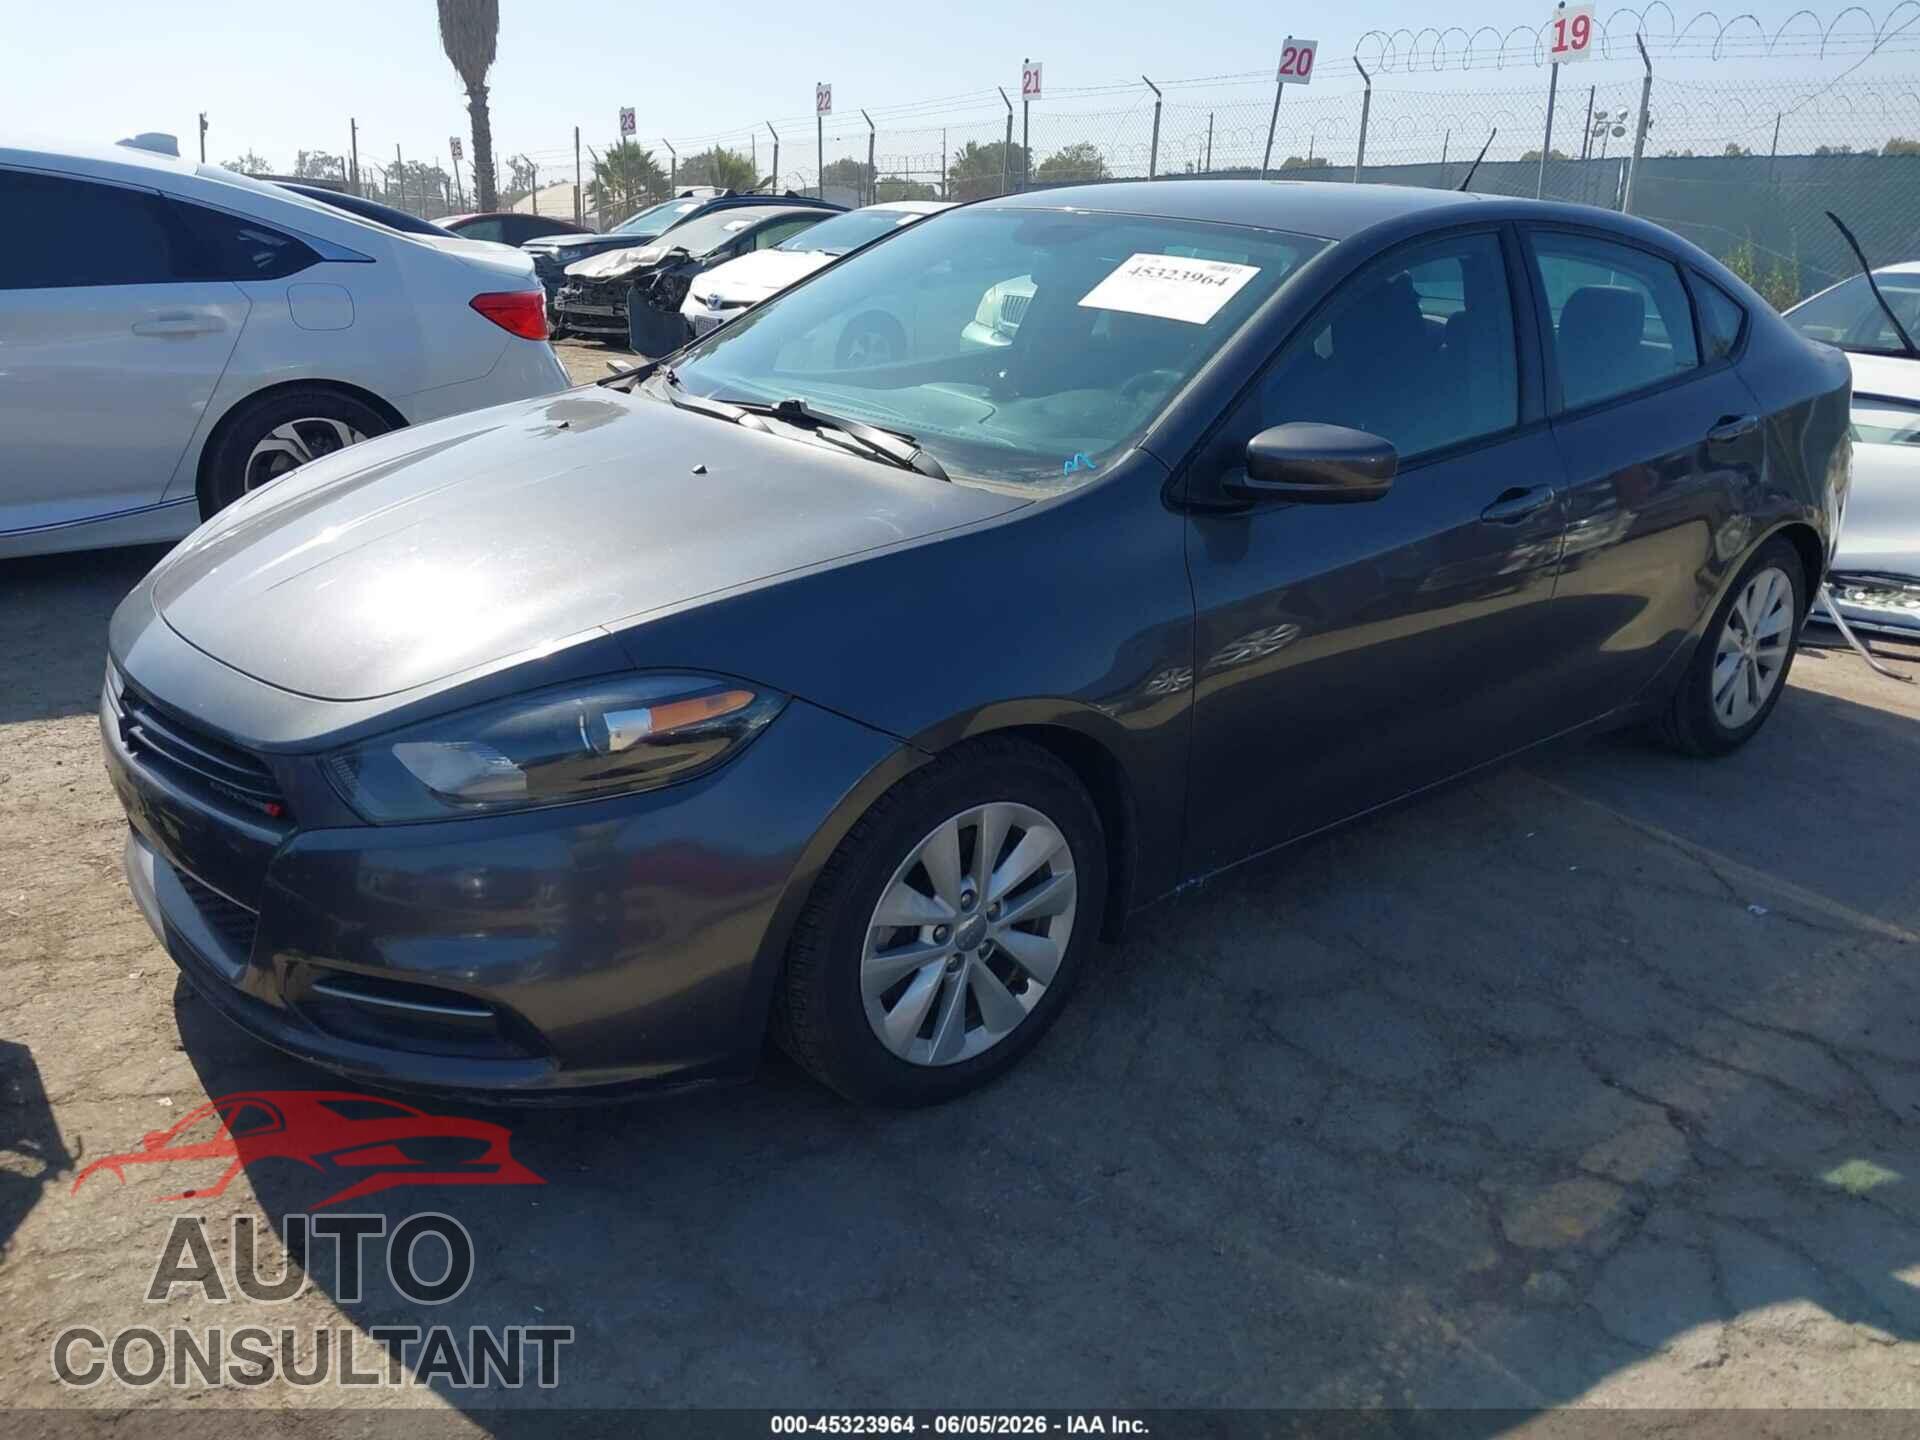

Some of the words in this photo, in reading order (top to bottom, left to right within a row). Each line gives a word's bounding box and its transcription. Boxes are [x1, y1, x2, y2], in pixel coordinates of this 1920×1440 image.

[1552, 15, 1590, 52] 19
[1280, 47, 1312, 76] 20
[1023, 70, 1040, 93] 21
[817, 91, 831, 111] 22
[620, 112, 636, 131] 23
[1128, 265, 1230, 287] 45323964
